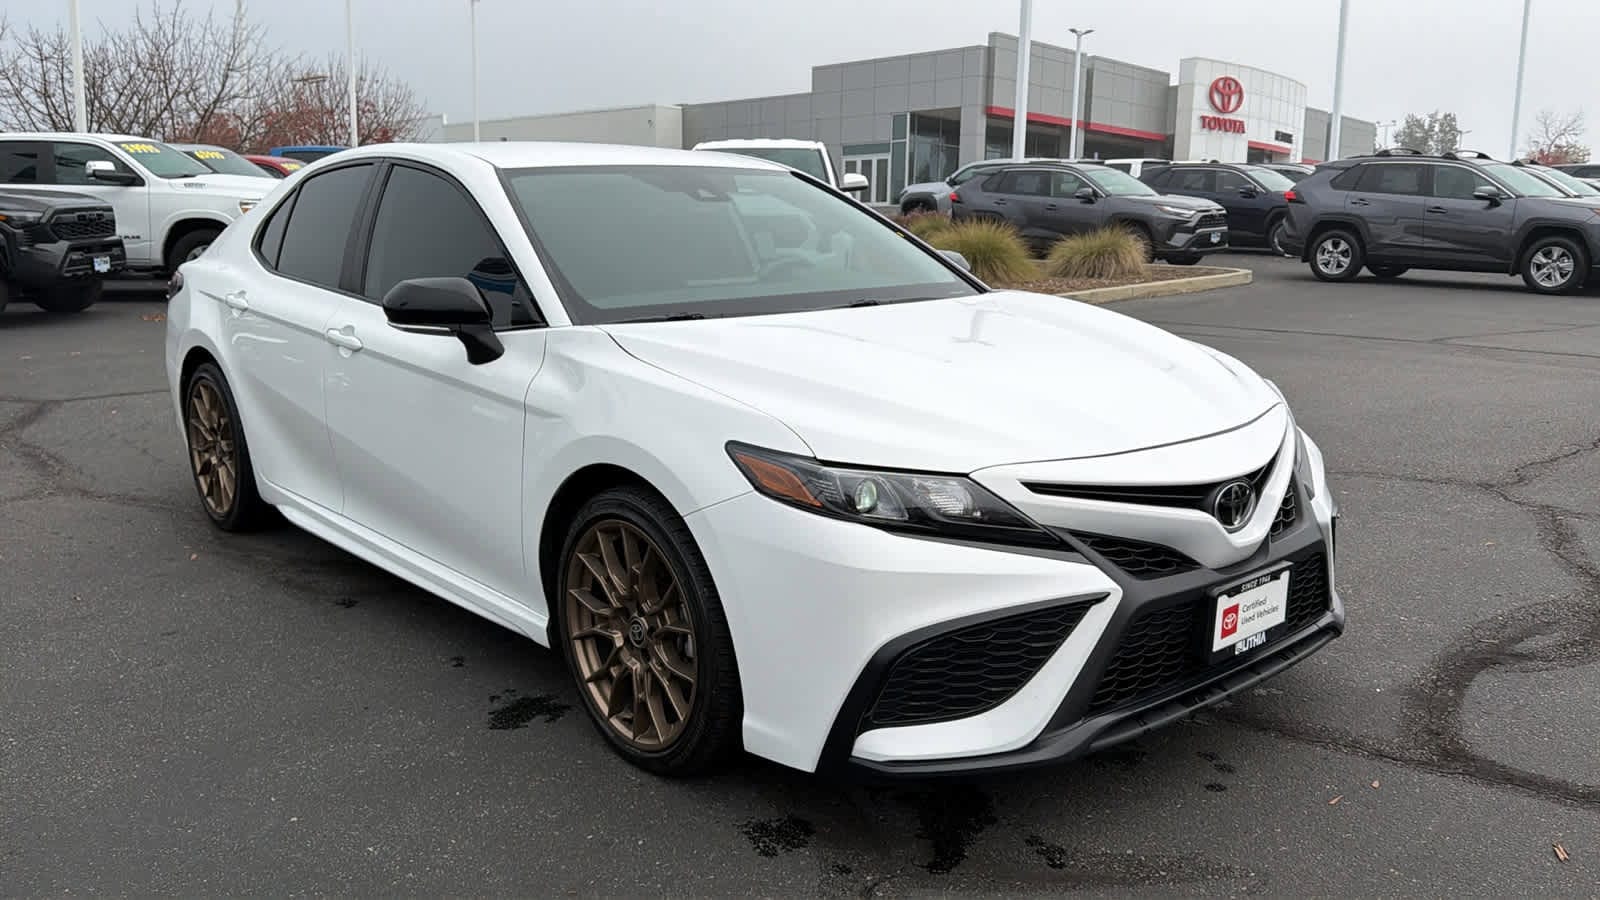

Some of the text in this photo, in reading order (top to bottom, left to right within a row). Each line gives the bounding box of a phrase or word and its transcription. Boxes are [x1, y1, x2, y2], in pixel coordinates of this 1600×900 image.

[1200, 115, 1246, 134] TOYOTA
[1241, 579, 1258, 592] SINCE
[1242, 597, 1267, 613] Certified
[1241, 605, 1279, 625] Used Vehicles
